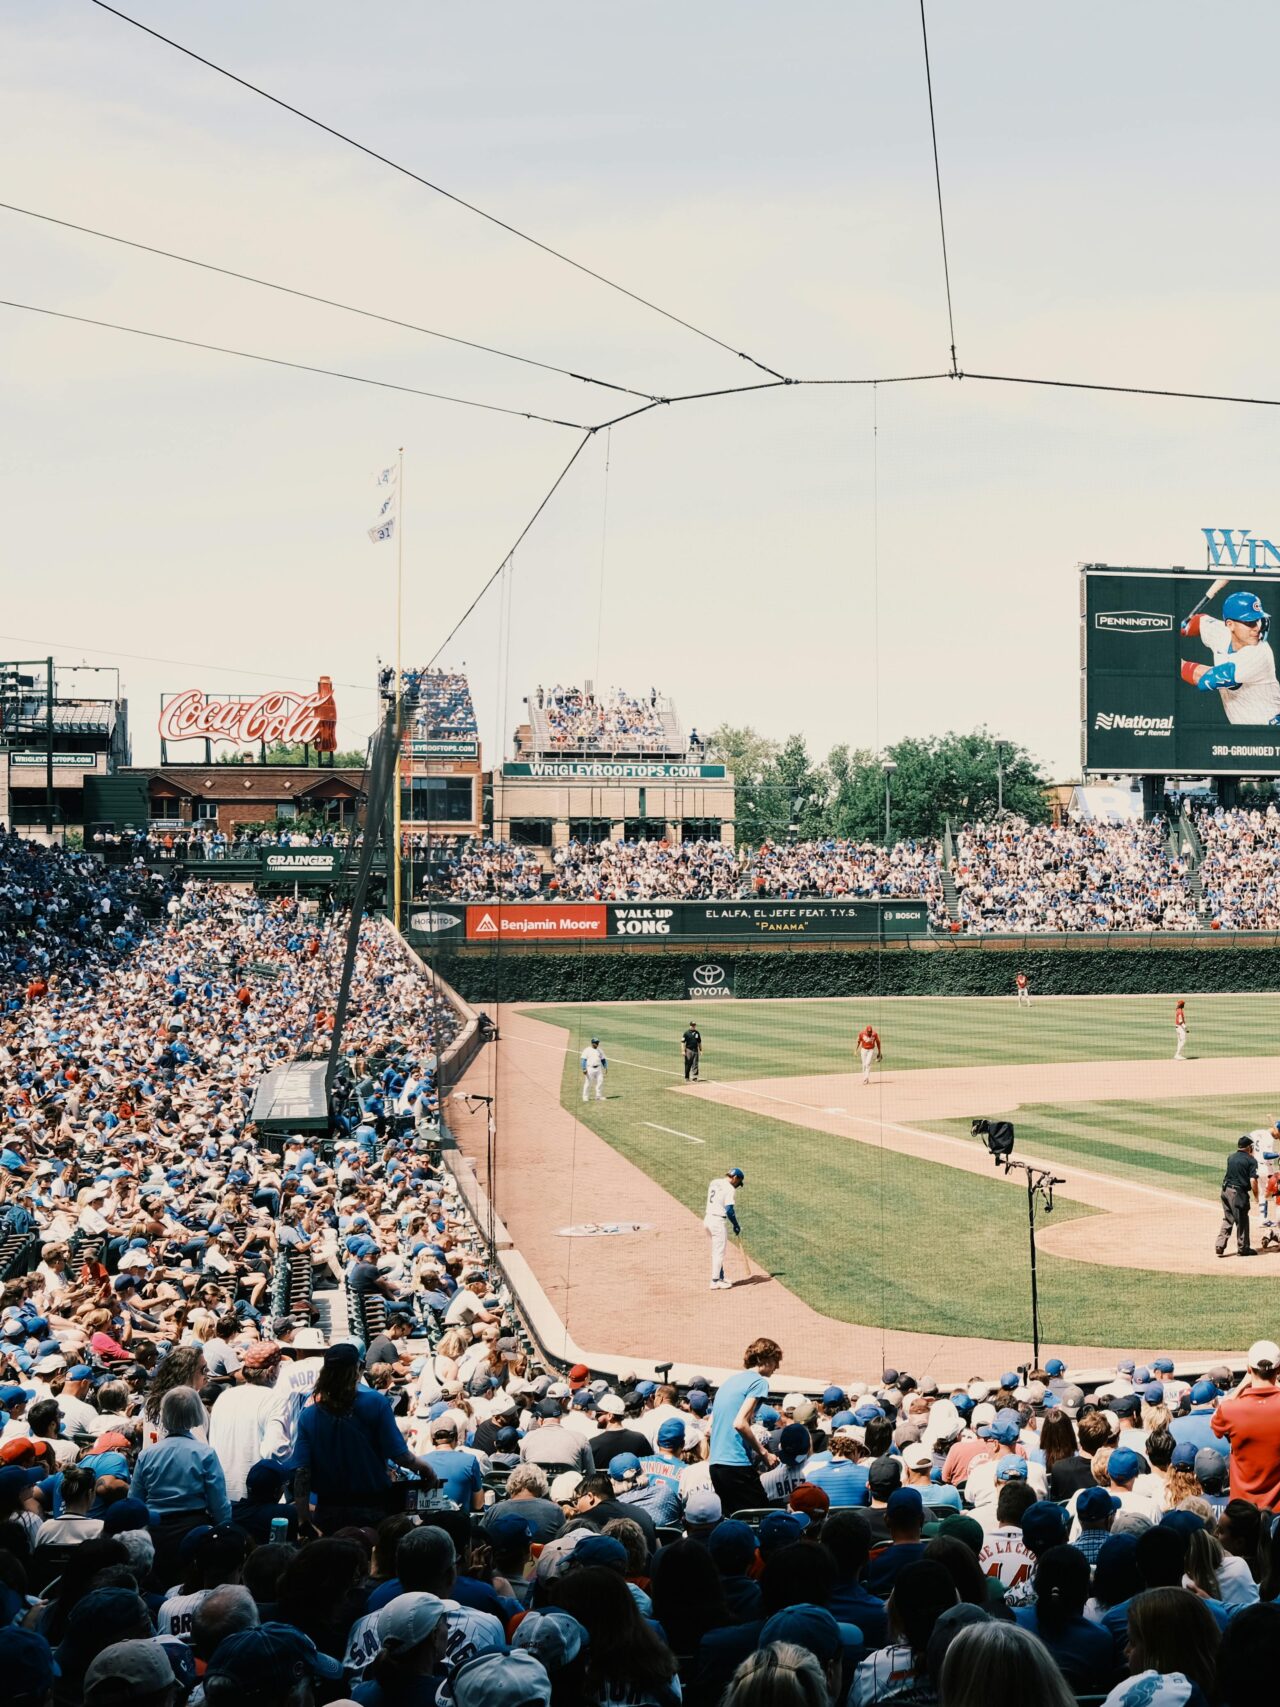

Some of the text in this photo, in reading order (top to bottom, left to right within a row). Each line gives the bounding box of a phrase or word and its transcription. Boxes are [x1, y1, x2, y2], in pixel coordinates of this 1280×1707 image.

[1099, 616, 1169, 626] PENNINGTON
[158, 689, 334, 745] Coca-Cola
[1112, 715, 1174, 729] National
[1212, 745, 1274, 757] 3RD-GROUNDED
[529, 763, 701, 777] WRIGLEYROOFTOPS.COM
[267, 855, 334, 866] GRAINGER
[614, 909, 674, 919] WALK-UP
[706, 910, 718, 918] EL
[721, 910, 750, 919] ALFA,
[754, 910, 767, 918] EL
[769, 909, 796, 918] JEFE
[799, 909, 828, 918] FEAT.
[895, 912, 921, 920] BOSCH
[414, 918, 454, 926] HORNITOS
[500, 919, 598, 932] Benjamin Moore
[616, 920, 671, 934] SONG
[688, 987, 730, 996] TOYOTA
[996, 1540, 1012, 1554] LA
[1016, 1542, 1038, 1564] CRU
